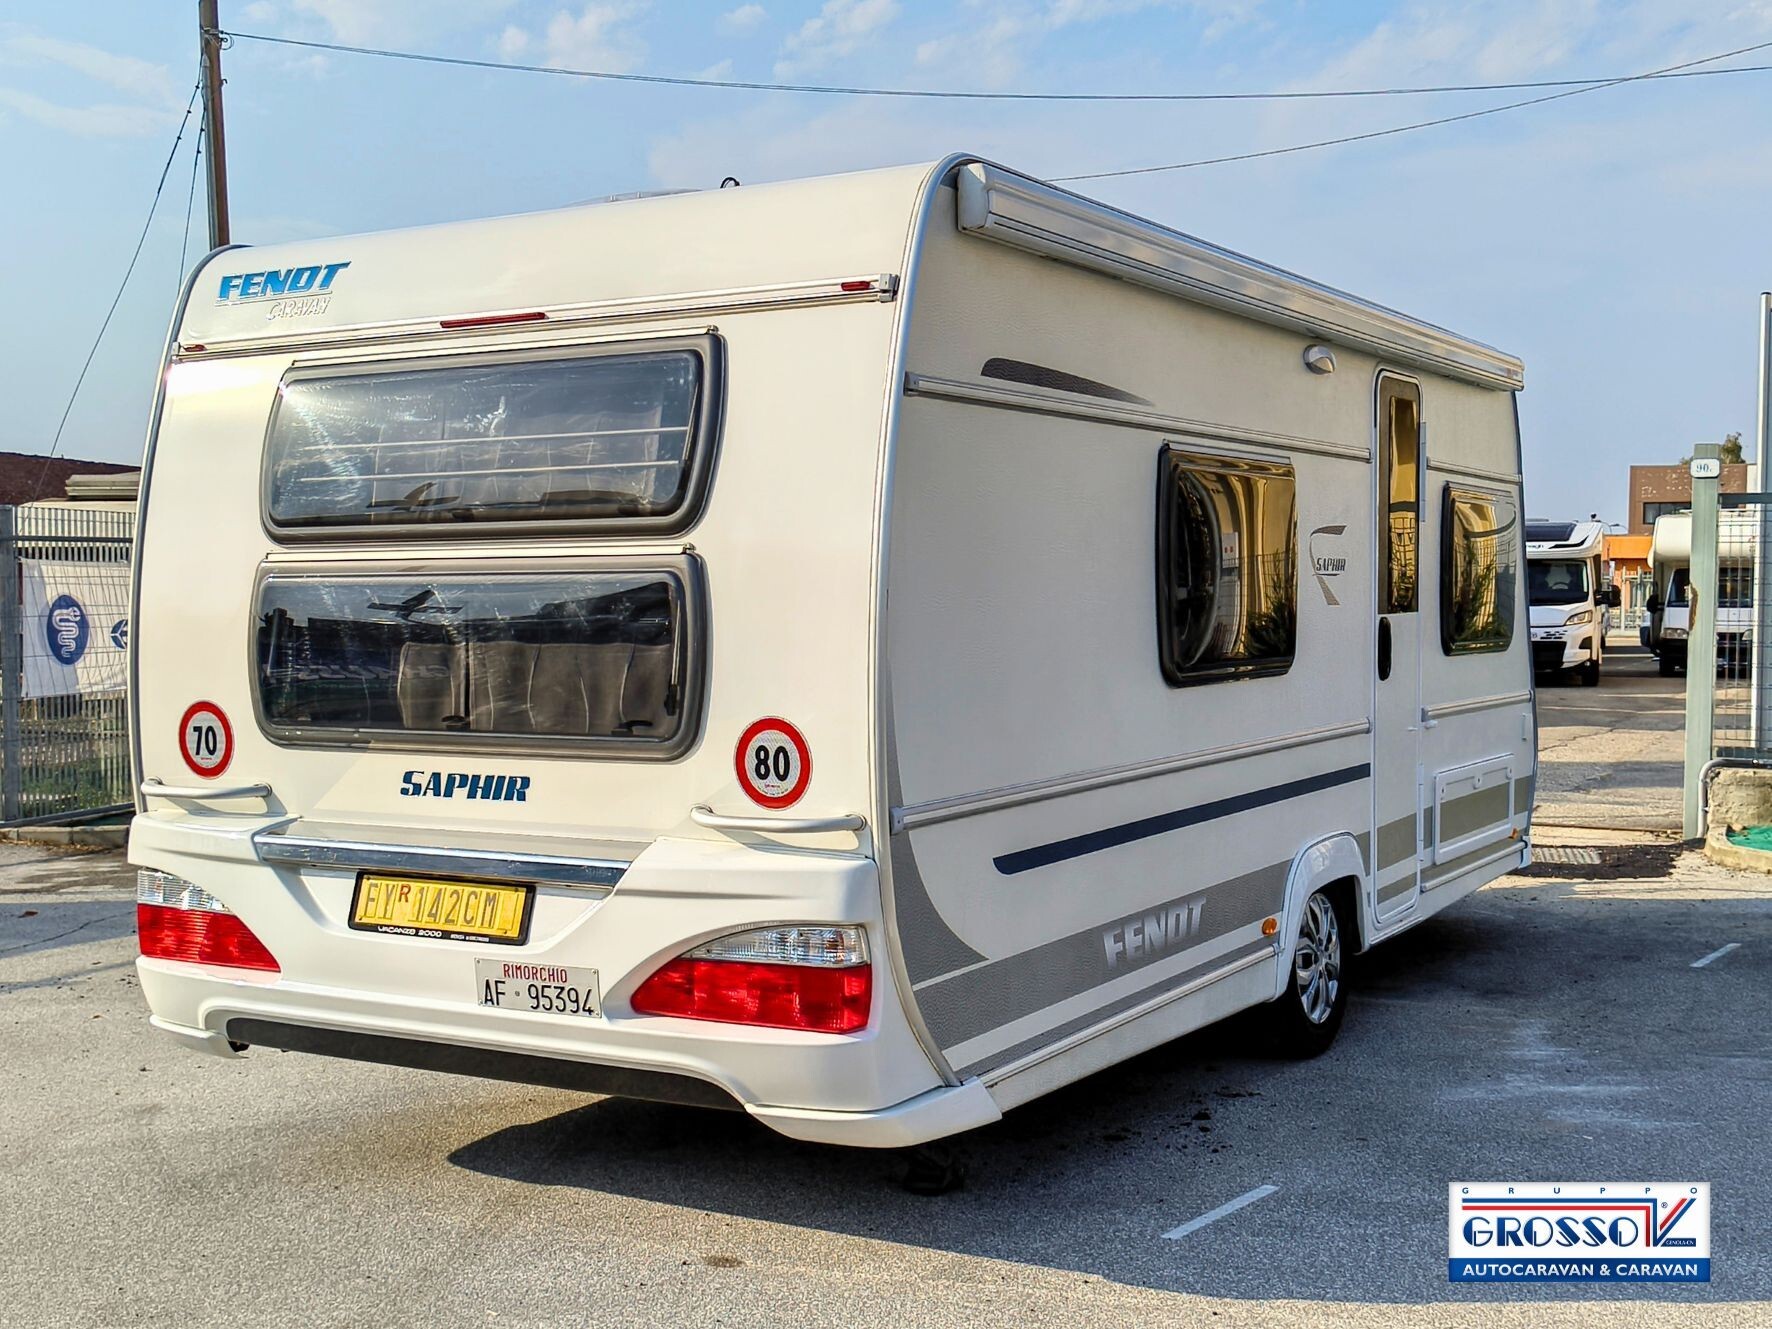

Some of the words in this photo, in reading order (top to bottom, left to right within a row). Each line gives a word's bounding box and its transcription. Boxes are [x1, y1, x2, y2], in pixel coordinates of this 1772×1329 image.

[218, 261, 351, 300] FENDT
[266, 297, 332, 320] CARAVAN
[193, 725, 218, 756] 70
[755, 744, 790, 782] 80
[400, 770, 531, 801] SAPHIR
[1103, 896, 1206, 971] FENDT
[502, 962, 568, 983] RIMORCHIO
[483, 978, 506, 1006] AF
[527, 983, 595, 1016] 95394
